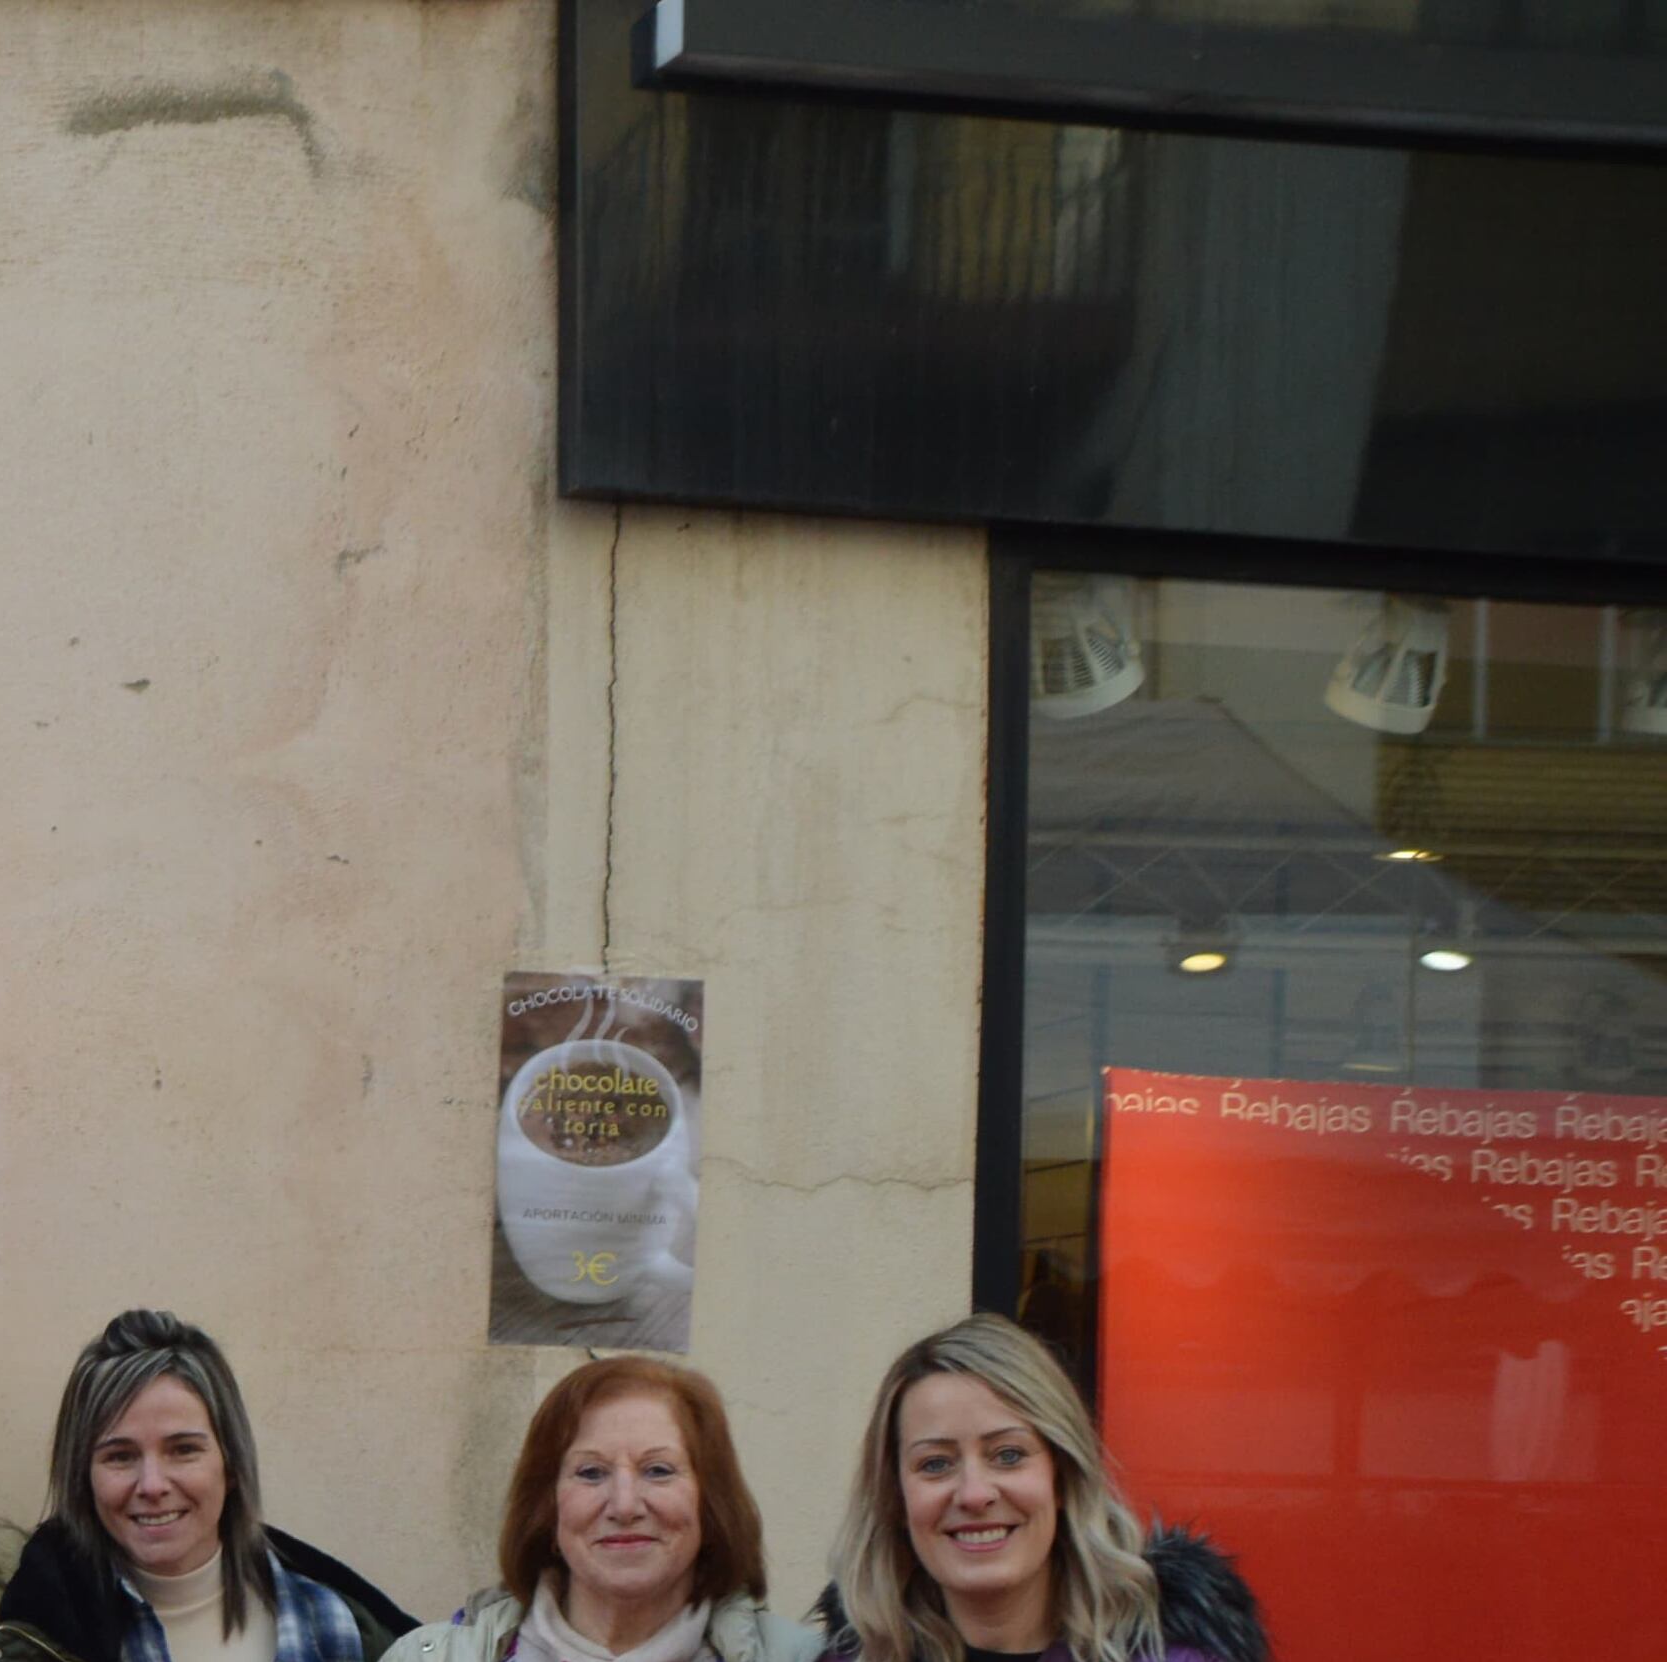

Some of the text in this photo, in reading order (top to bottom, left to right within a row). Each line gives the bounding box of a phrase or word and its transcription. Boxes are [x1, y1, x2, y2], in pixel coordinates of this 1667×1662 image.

[507, 984, 700, 1033] CHOCOLATE SOLIDARIO
[534, 1065, 660, 1096] chocolate
[563, 1119, 621, 1138] torta
[625, 1101, 668, 1118] con
[1389, 1099, 1537, 1145] Rebajas
[1470, 1149, 1618, 1194] Rebajas
[570, 1249, 620, 1287] 3€
